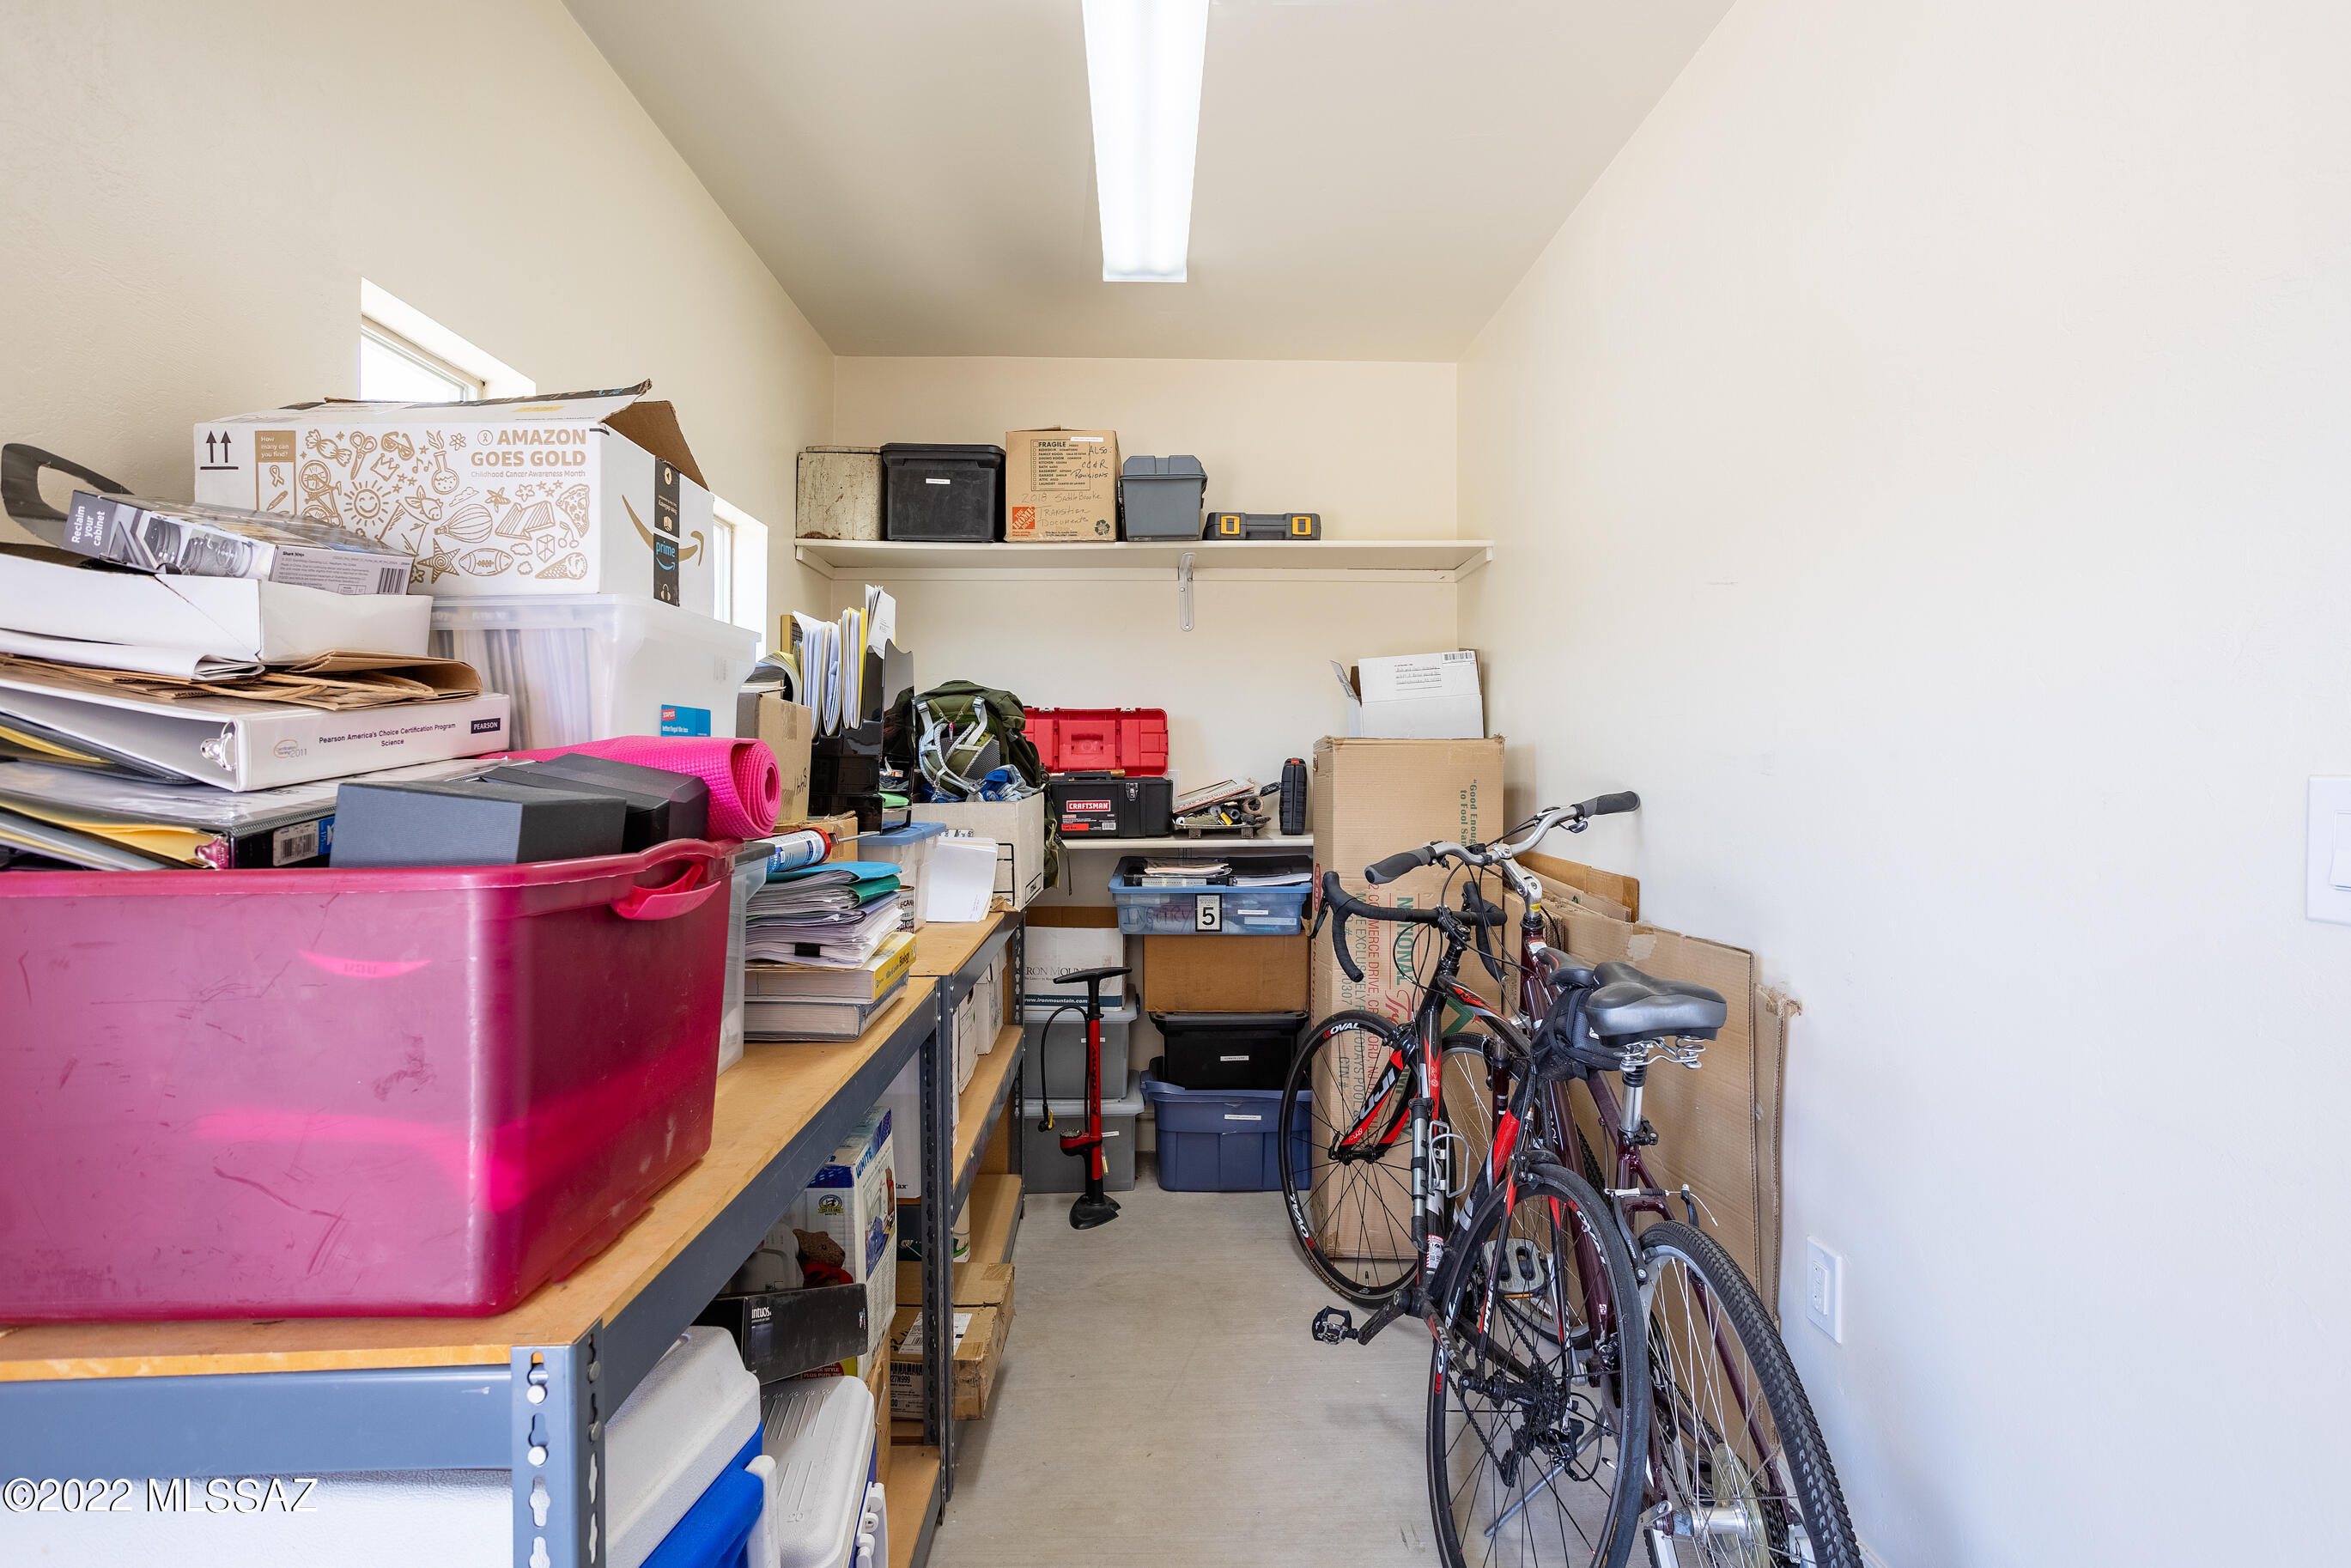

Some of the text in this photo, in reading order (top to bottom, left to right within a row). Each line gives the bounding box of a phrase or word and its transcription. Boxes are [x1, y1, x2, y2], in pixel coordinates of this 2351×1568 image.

[496, 429, 586, 445] AMAZON
[471, 450, 586, 467] GOES GOLD
[71, 505, 85, 543] Reclaim
[84, 515, 94, 538] your
[94, 511, 105, 546] cabinet
[1012, 506, 1035, 529] HOME
[1021, 515, 1035, 529] DEPOT
[656, 541, 676, 558] prime
[319, 722, 456, 744] Pearson America's Choice Certification Program
[474, 721, 498, 730] PEARSON
[290, 748, 307, 758] 2011
[381, 738, 404, 747] Science
[1460, 790, 1468, 800] to
[1469, 813, 1477, 845] Enoug
[1202, 907, 1215, 926] 5
[1369, 894, 1379, 958] COMERCE
[1396, 897, 1414, 985] NTIONAL
[1026, 967, 1047, 976] RON
[1355, 929, 1366, 1002] EXCLUSELY
[1367, 961, 1379, 997] DRIVE,
[1330, 1022, 1360, 1035] OVAL
[1367, 1000, 1379, 1062] CRORD,
[1340, 1057, 1350, 1078] CTN
[1353, 1077, 1364, 1107] POOL
[856, 1146, 873, 1179] WHITE
[1290, 1193, 1310, 1238] OVAL
